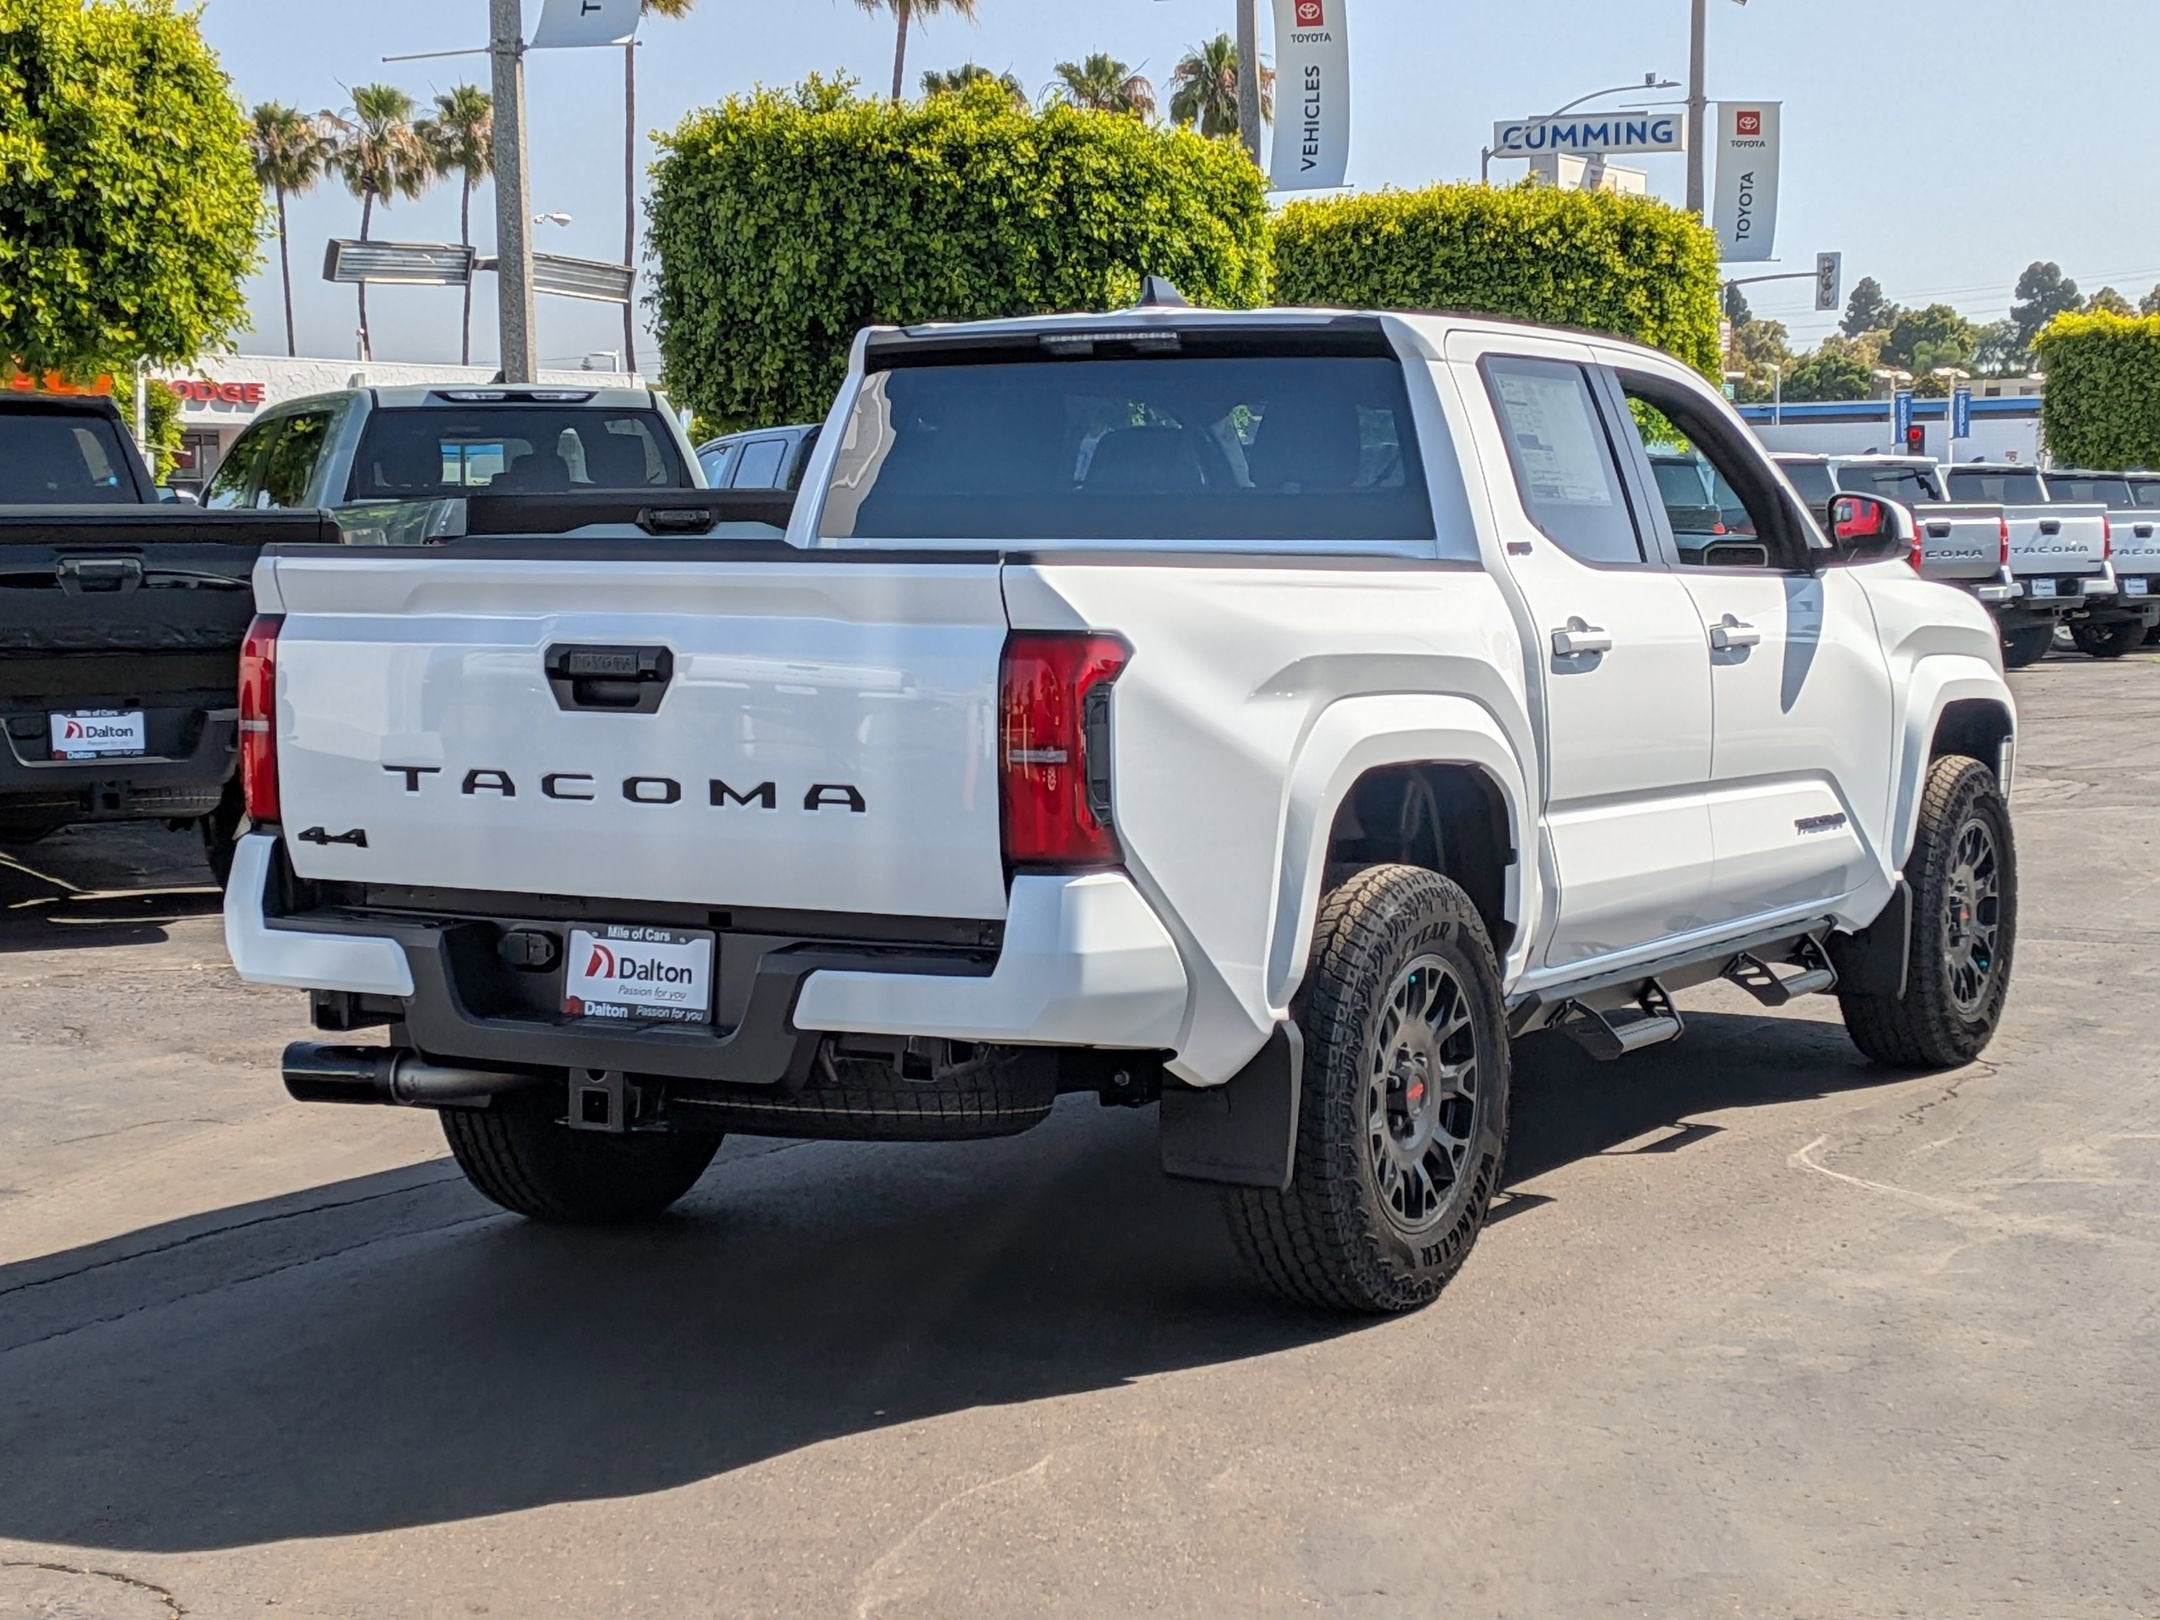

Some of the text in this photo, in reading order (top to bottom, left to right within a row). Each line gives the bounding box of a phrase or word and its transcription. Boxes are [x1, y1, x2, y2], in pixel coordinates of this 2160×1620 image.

[1291, 33, 1332, 43] TOYOTA
[1301, 65, 1320, 172] VEHICLES
[1503, 120, 1672, 149] CUMMING
[1736, 171, 1754, 242] TOYOTA
[171, 380, 265, 404] ODGE
[1925, 549, 1983, 558] COMA
[2011, 545, 2088, 554] TACOMA
[572, 655, 632, 671] TOYOTA
[86, 725, 134, 738] Dalton
[382, 764, 867, 813] TACOMA
[608, 926, 671, 941] Mile of Cars
[619, 957, 693, 984] Dalton
[618, 985, 687, 1000] Passion for you
[584, 1001, 704, 1022] Dalton Passion for you
